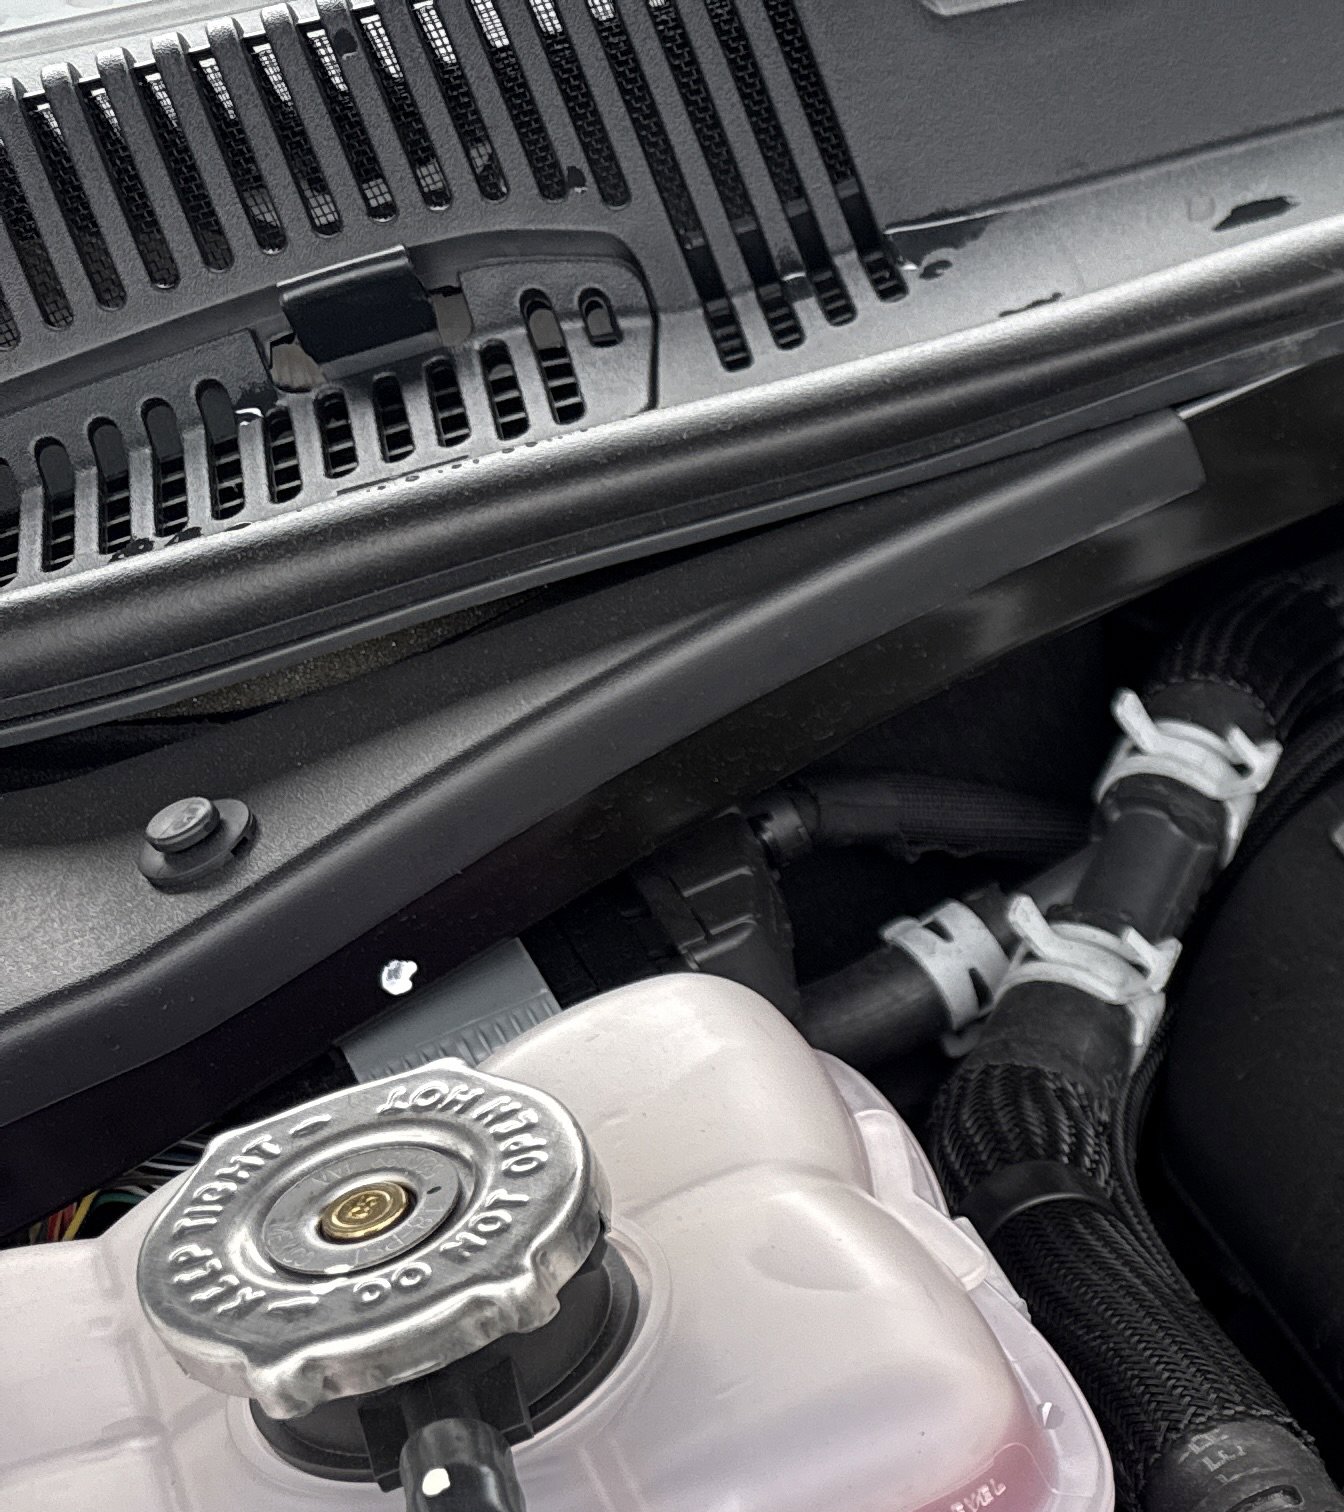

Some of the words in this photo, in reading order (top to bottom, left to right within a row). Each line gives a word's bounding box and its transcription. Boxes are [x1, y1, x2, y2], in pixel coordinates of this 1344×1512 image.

[377, 1081, 484, 1114] HOT
[473, 1095, 548, 1173] OPEN
[172, 1134, 282, 1237] TIGHT
[439, 1188, 530, 1257] NOT
[169, 1246, 267, 1314] KEEP
